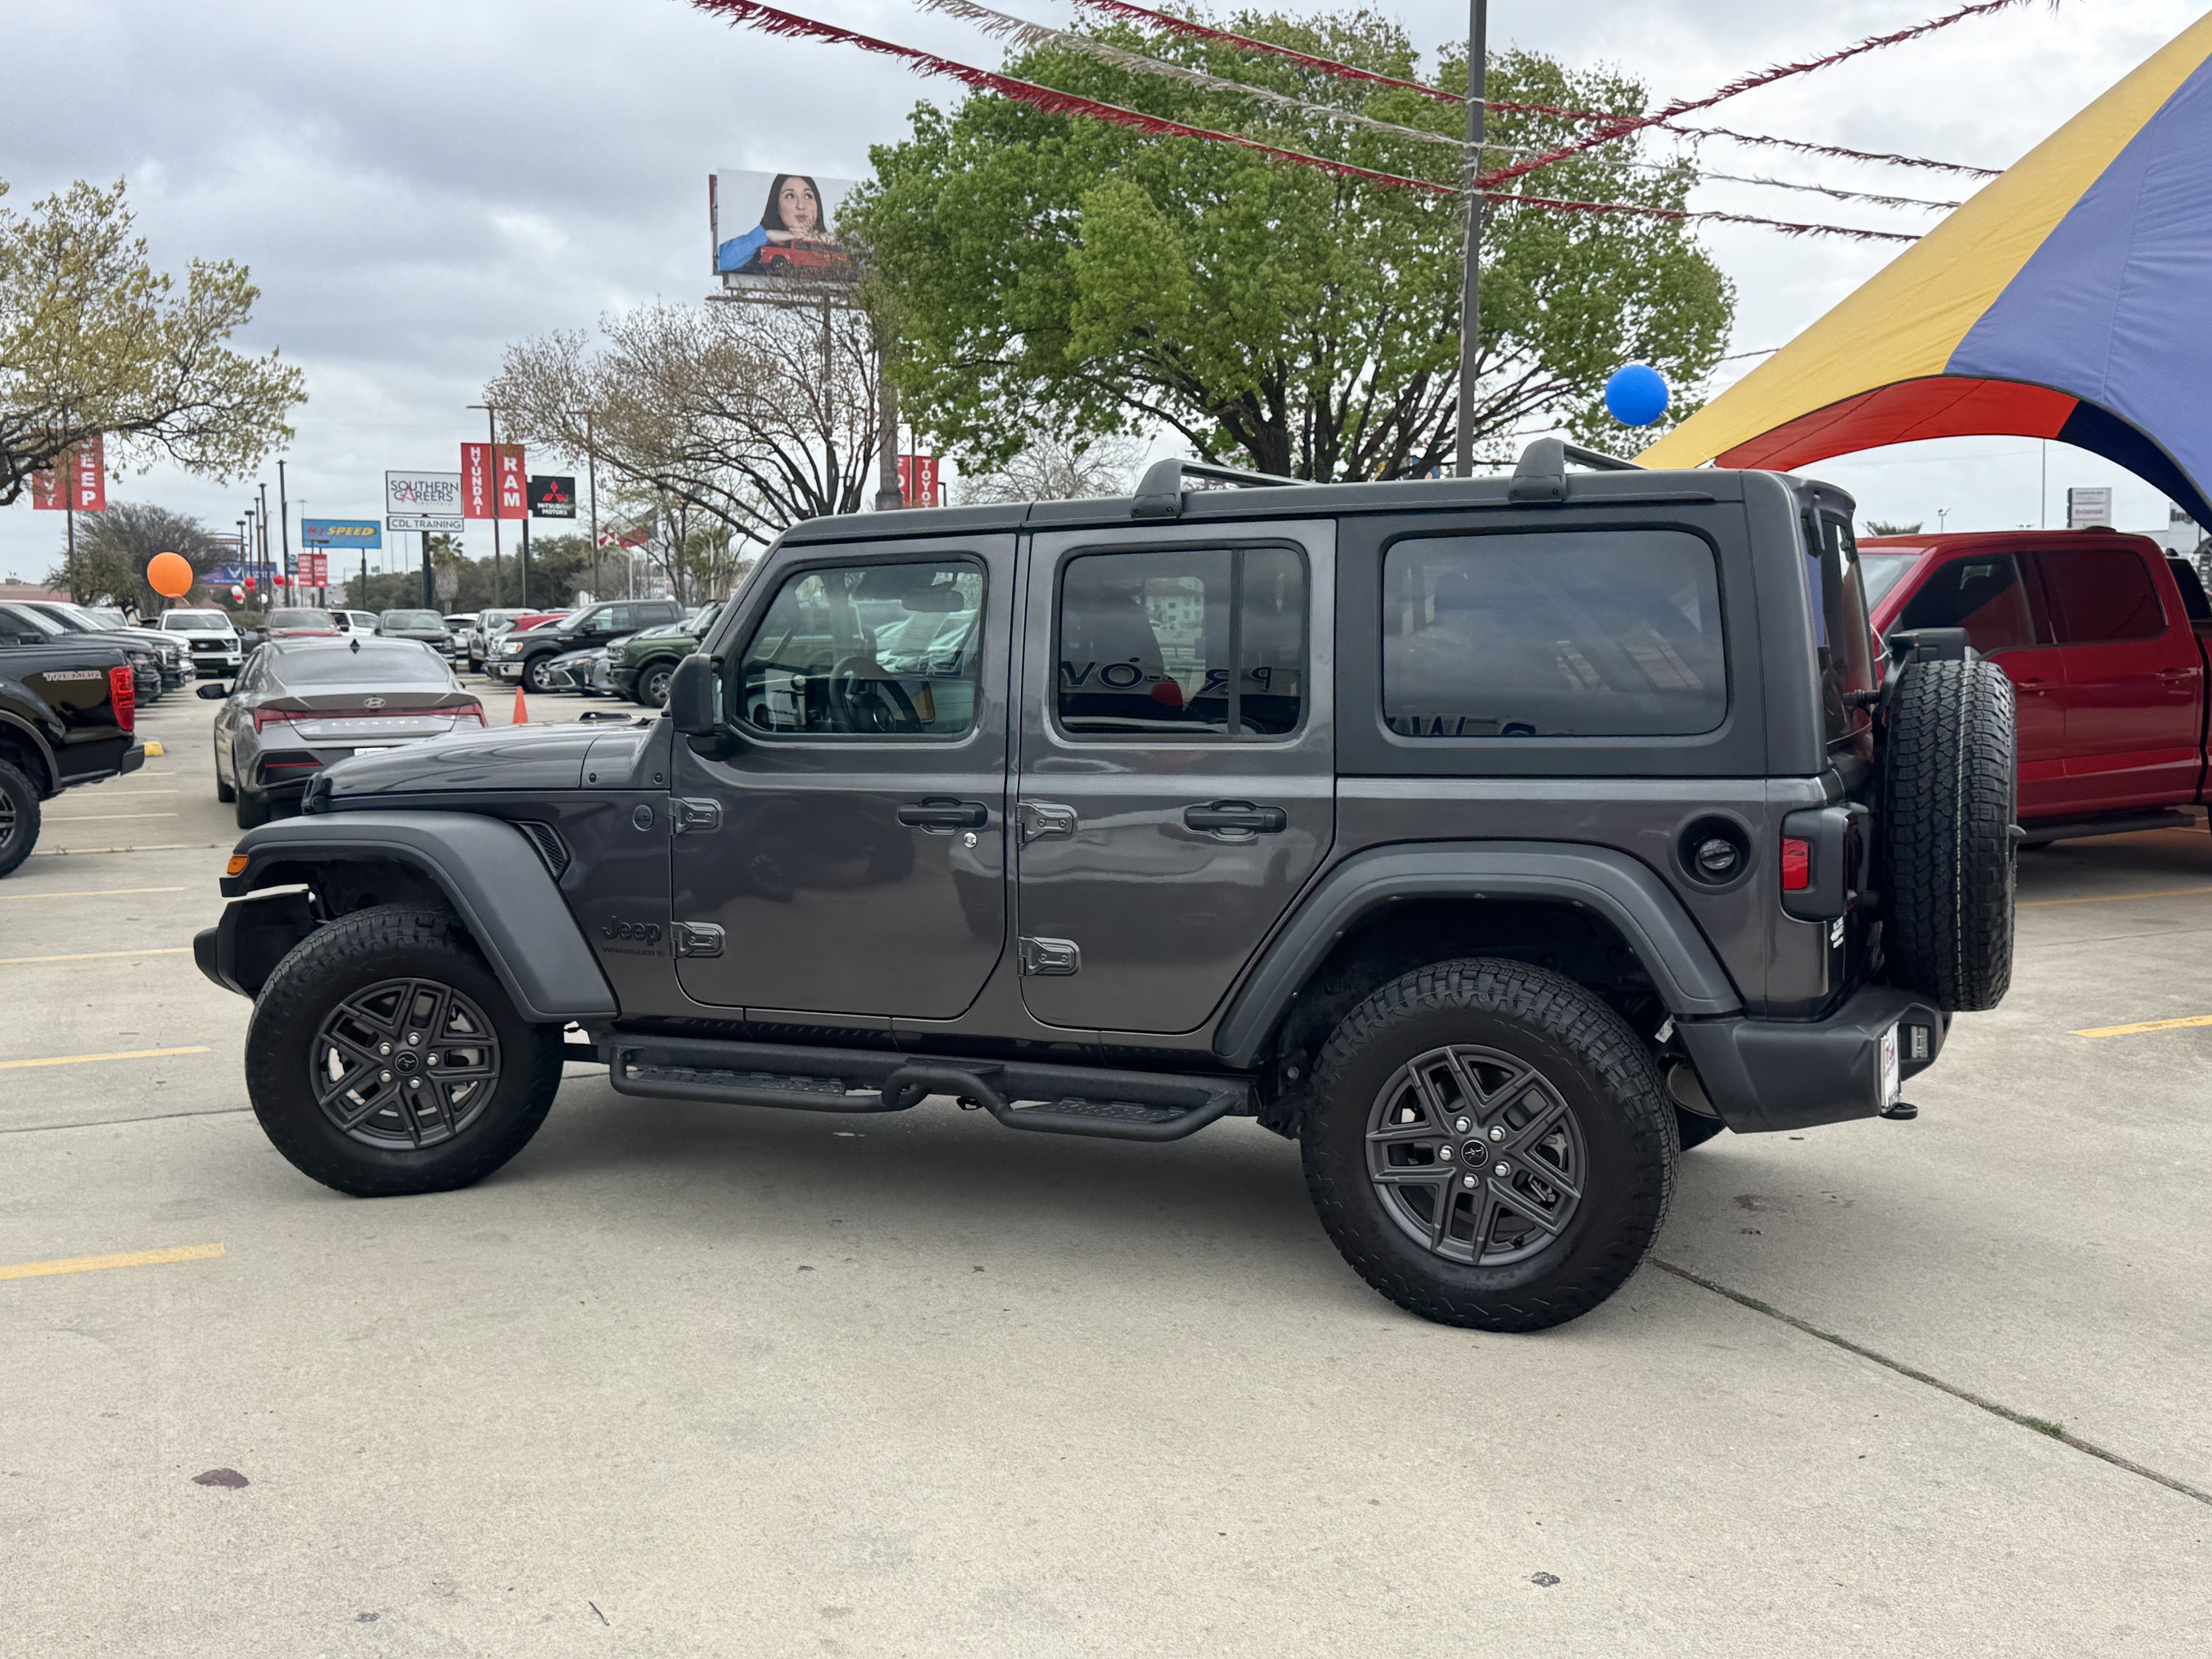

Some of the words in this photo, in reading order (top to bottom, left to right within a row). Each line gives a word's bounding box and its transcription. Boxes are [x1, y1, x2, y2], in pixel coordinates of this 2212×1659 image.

[391, 480, 459, 493] SOUTHERN
[470, 446, 483, 515] HYUNDAI
[504, 456, 520, 507] RAM
[921, 459, 931, 508] TOYOT
[394, 485, 453, 503] CAREERS
[327, 526, 377, 536] SPEED
[392, 519, 411, 528] CDL
[414, 520, 461, 529] TRAINING
[602, 915, 661, 946] Jeep
